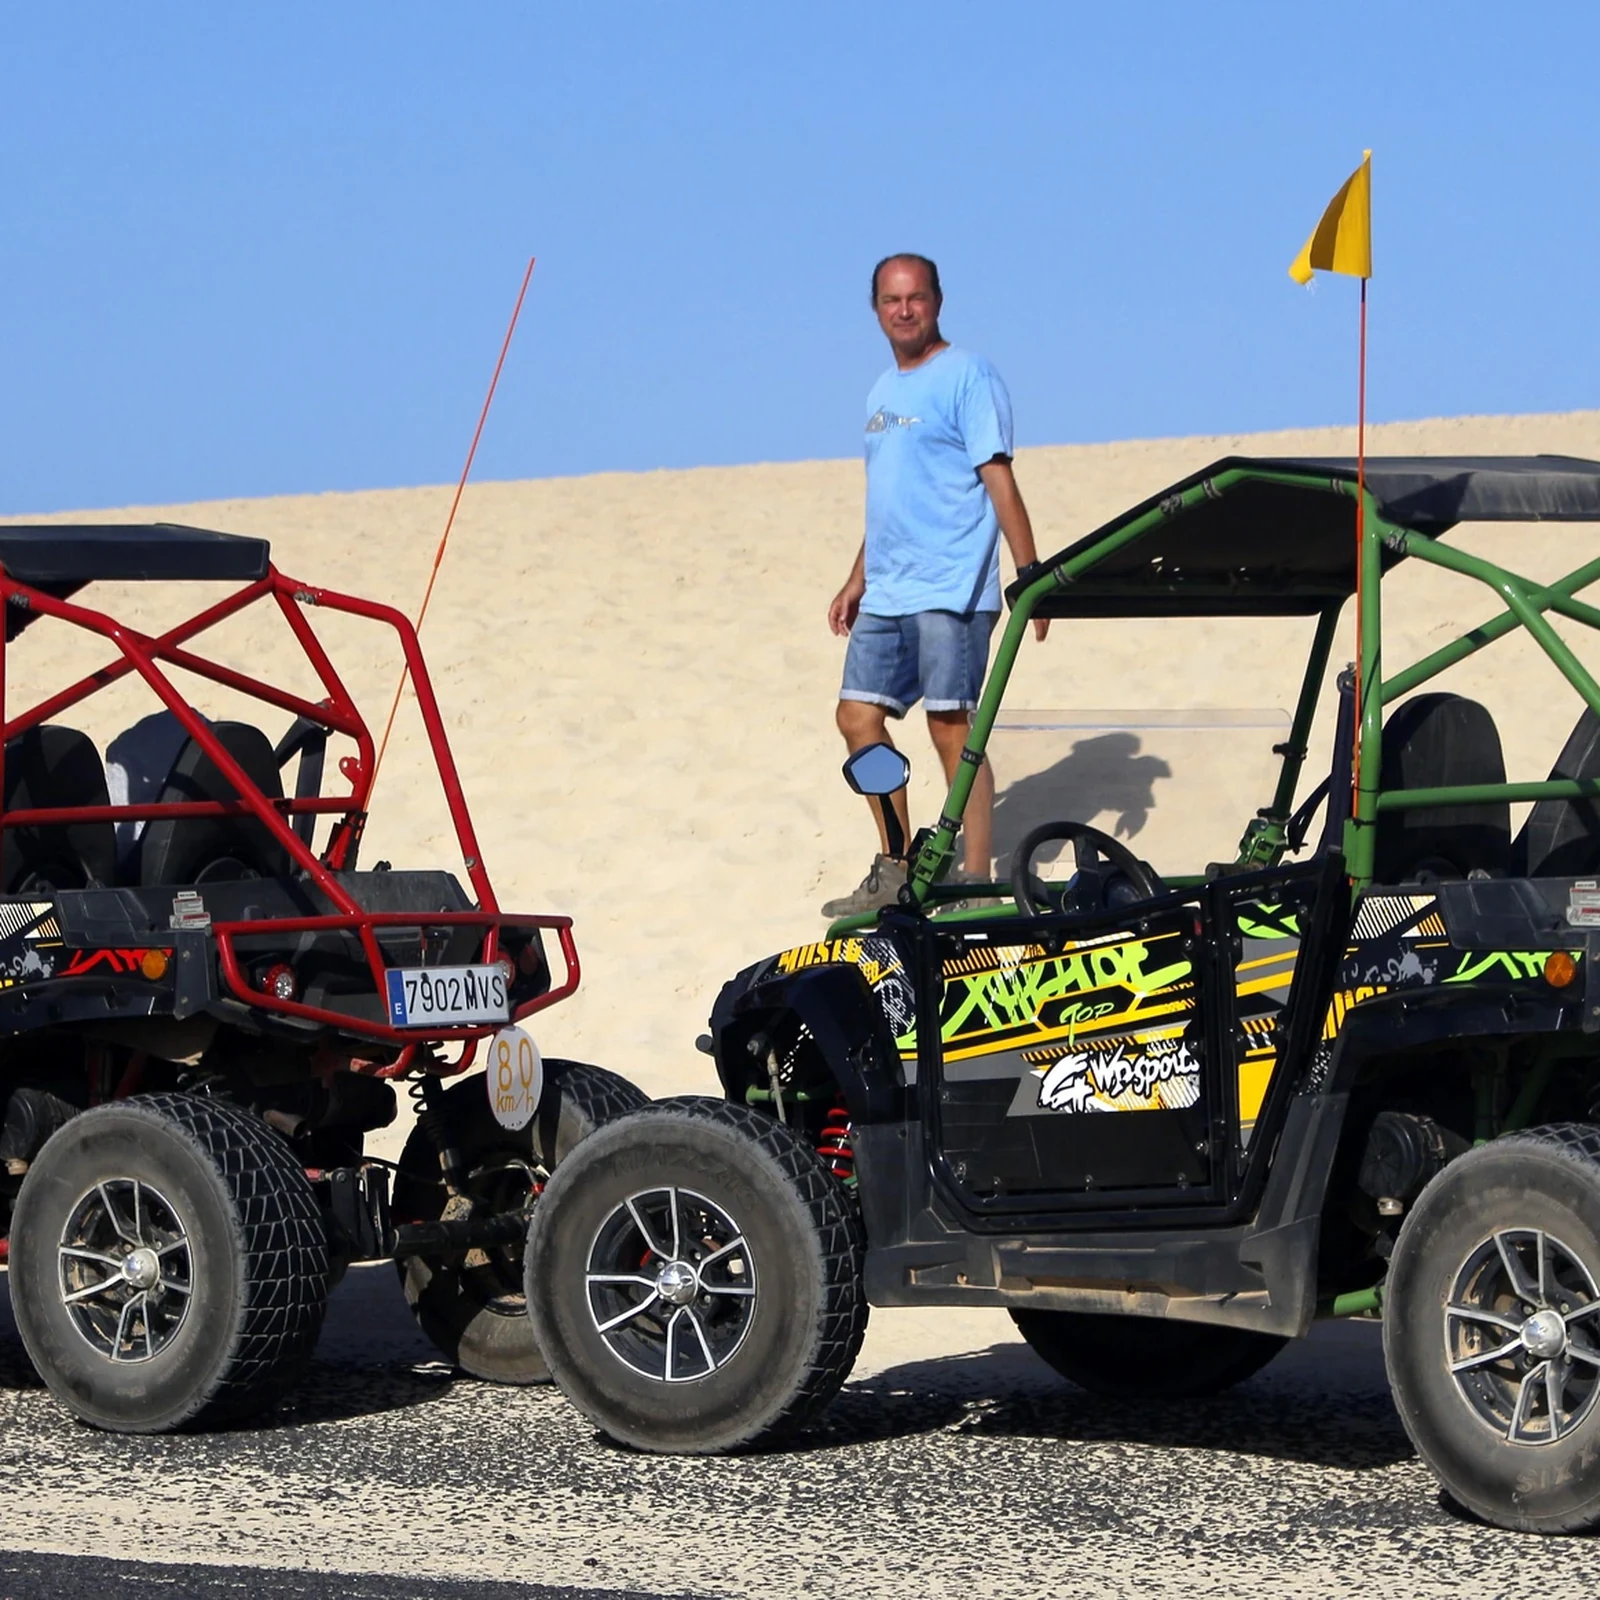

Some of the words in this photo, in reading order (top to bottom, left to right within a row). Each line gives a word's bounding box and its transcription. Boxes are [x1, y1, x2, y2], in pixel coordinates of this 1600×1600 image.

[395, 1003, 403, 1015] E
[405, 975, 505, 1014] 7902MVS
[497, 1037, 533, 1092] 80
[496, 1088, 534, 1113] km/h
